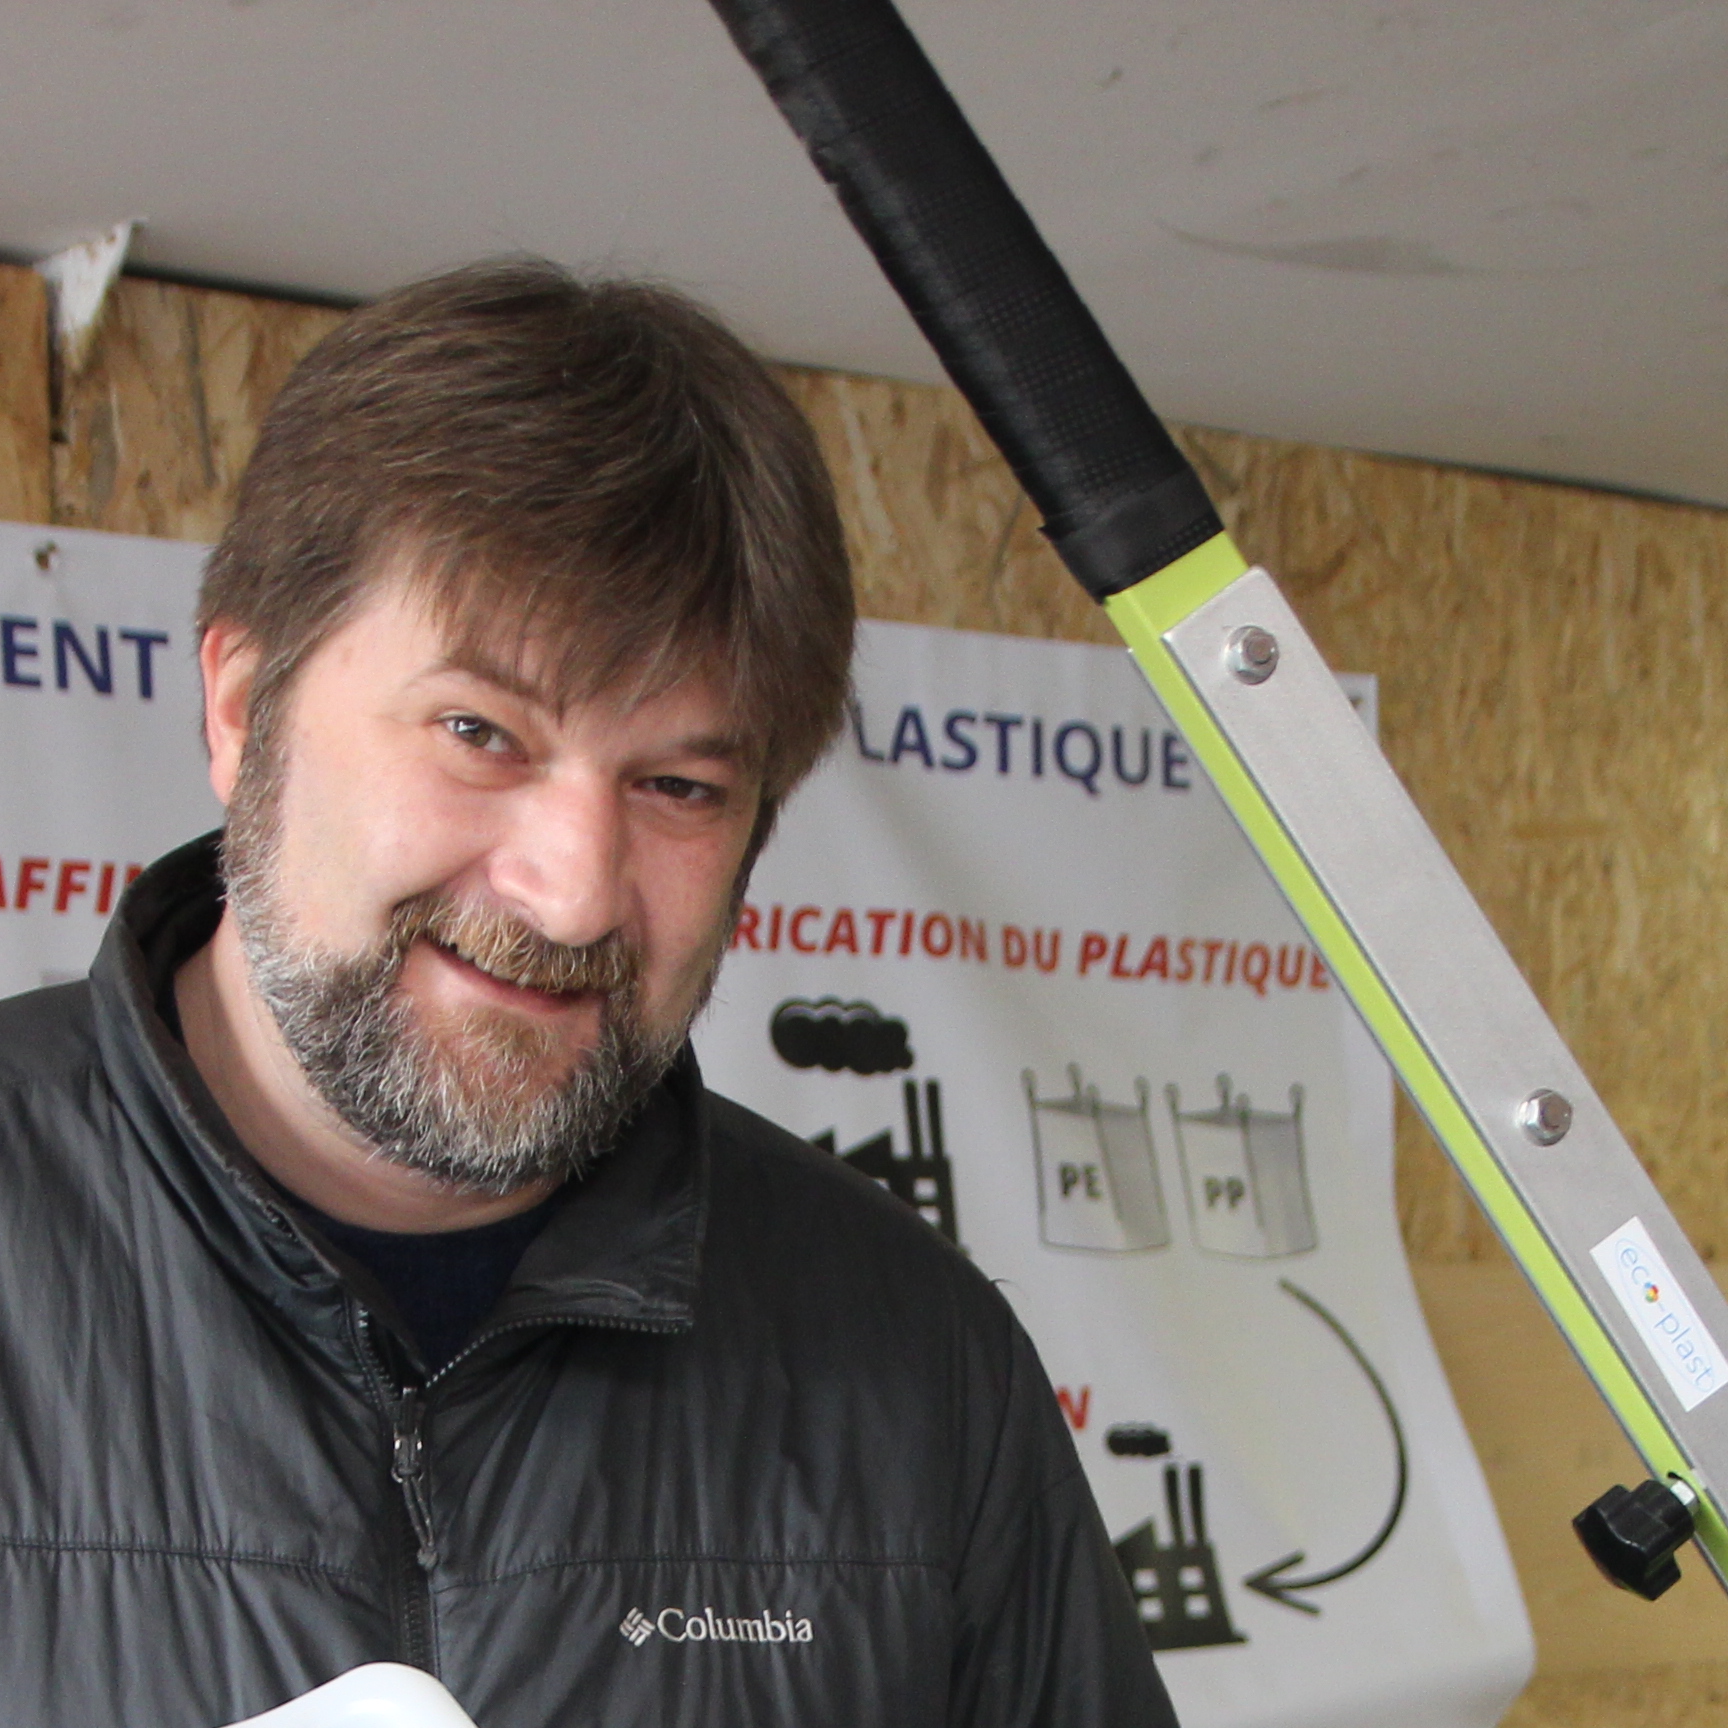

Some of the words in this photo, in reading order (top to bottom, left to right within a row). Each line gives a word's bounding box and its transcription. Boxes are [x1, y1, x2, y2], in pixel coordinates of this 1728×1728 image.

[1002, 924, 1062, 973] DU
[1076, 930, 1330, 997] PLASTIQUE
[1059, 1161, 1102, 1199] PE
[1203, 1174, 1246, 1209] PP
[657, 1606, 814, 1643] Columbia
